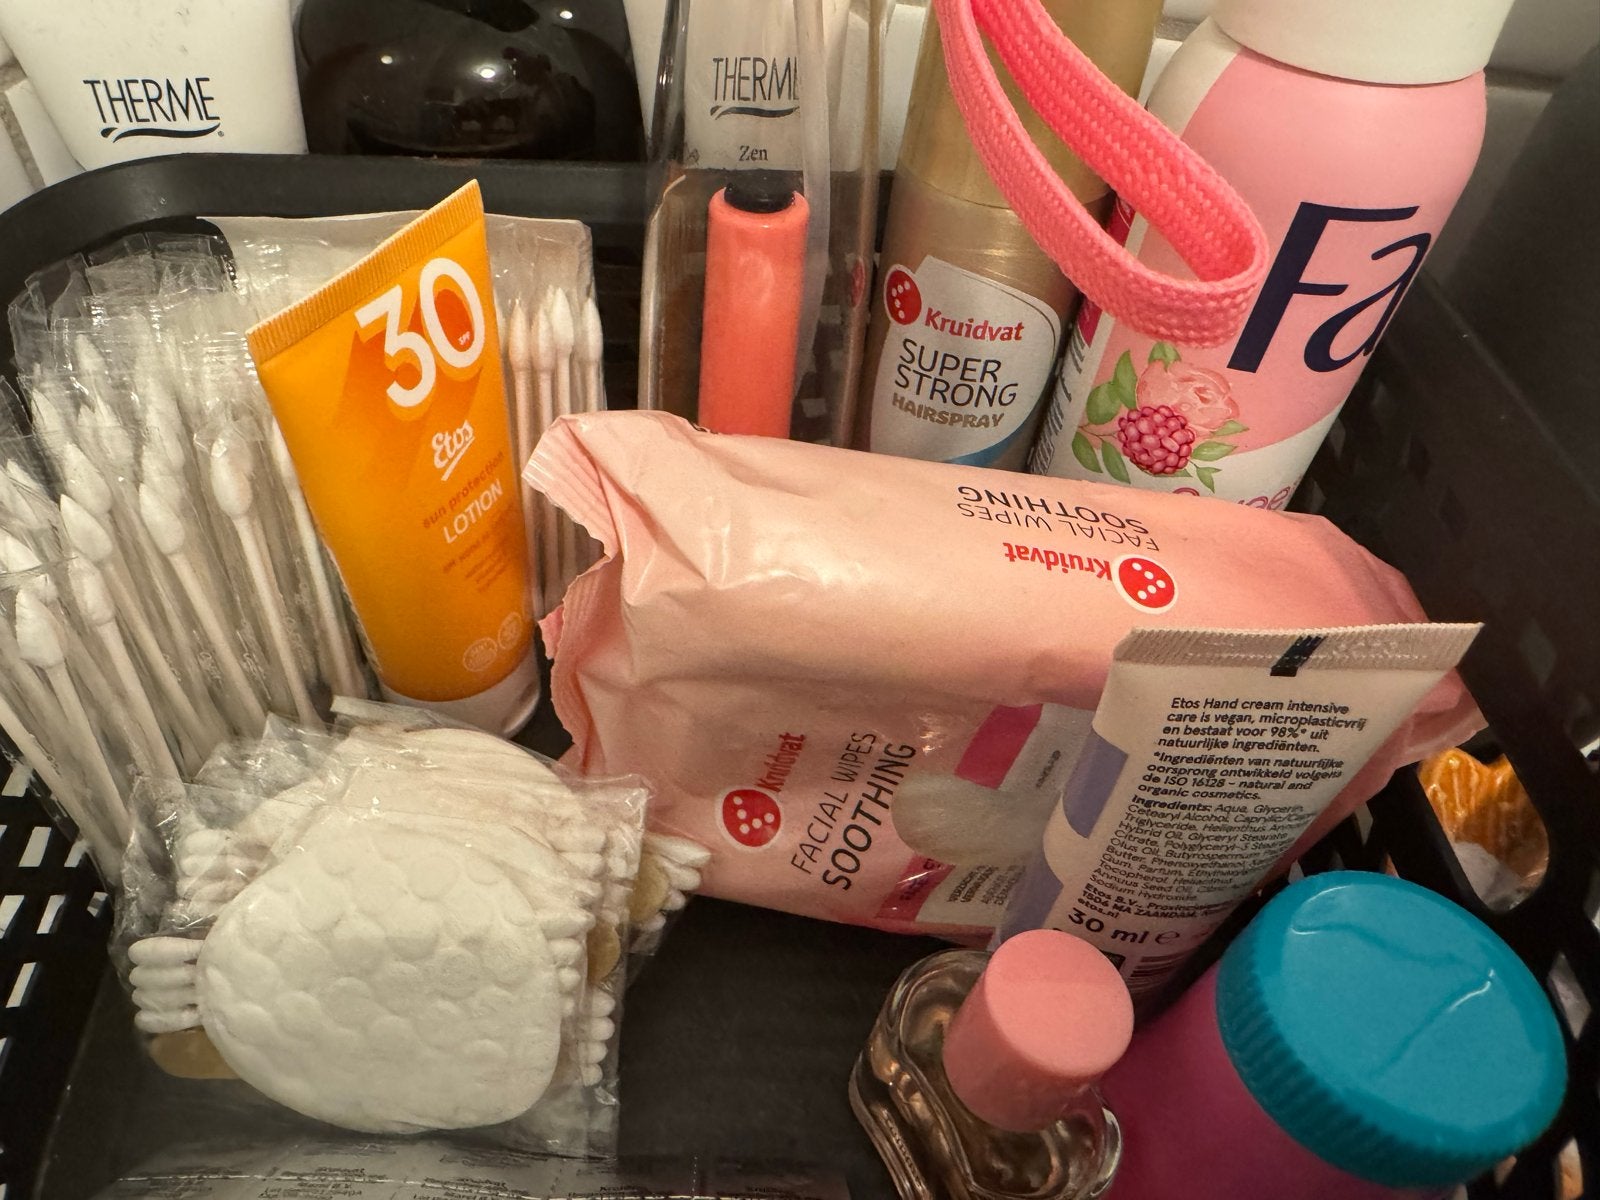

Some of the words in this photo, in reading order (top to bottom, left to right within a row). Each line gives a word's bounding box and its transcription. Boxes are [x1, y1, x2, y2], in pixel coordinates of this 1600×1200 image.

[83, 77, 220, 123] THERME
[738, 145, 769, 161] Zen
[1226, 202, 1432, 374] Fa
[354, 257, 485, 407] 30
[924, 307, 1025, 342] Kruidvat
[899, 338, 1002, 383] SUPER
[894, 364, 1019, 408] STRONG
[892, 393, 1005, 428] HAIRSPRAY
[431, 420, 475, 470] Etos
[423, 508, 449, 529] sun
[448, 451, 505, 512] protection
[443, 478, 503, 543] LOTION
[957, 486, 1150, 535] SOOTHING
[957, 503, 1052, 532] WIPES
[1058, 519, 1160, 552] FACIAL
[1002, 542, 1113, 581] Kruidvat
[1171, 697, 1201, 709] Etos
[1203, 698, 1239, 709] Hand
[1241, 700, 1284, 711] cream
[1287, 700, 1350, 715] intensive
[1162, 725, 1180, 735] en
[1183, 725, 1233, 736] bestaat
[1236, 727, 1268, 737] voor
[1310, 729, 1330, 740] uit
[1167, 713, 1198, 723] care
[1200, 712, 1211, 723] is
[1214, 713, 1255, 726] vegan,
[1259, 713, 1367, 732] microplasticvrij
[1158, 738, 1229, 751] natuurlijke
[1232, 738, 1320, 753] ingrediënten.
[754, 732, 807, 793] Kruidvat
[1147, 764, 1218, 779] oorsprong
[1220, 767, 1293, 779] ontwikkeld
[1295, 770, 1343, 781] volgens
[1248, 758, 1271, 767] van
[1273, 757, 1345, 770] natuurlijke
[1138, 784, 1189, 798] organic
[1192, 789, 1262, 800] cosmetics.
[1142, 773, 1161, 784] de
[1164, 775, 1188, 786] ISO
[1192, 777, 1226, 788] 16128
[1239, 779, 1286, 790] natural
[1287, 781, 1314, 790] and
[790, 791, 849, 875] FACIAL
[830, 732, 877, 783] WIPES
[822, 743, 917, 891] SOOTHING
[1128, 804, 1181, 822] Cetearyl
[1131, 794, 1212, 812] Ingredients:
[1110, 837, 1139, 853] Olus
[1119, 821, 1162, 838] Hybrid
[1188, 832, 1238, 844] Glyceryl
[1084, 882, 1112, 900] Etos
[1089, 874, 1136, 895] Sodium
[1077, 897, 1120, 919] etos.nl
[1082, 889, 1109, 908] 1506
[1112, 903, 1132, 914] MA
[1068, 907, 1104, 933] 30
[1111, 929, 1150, 944] ml
